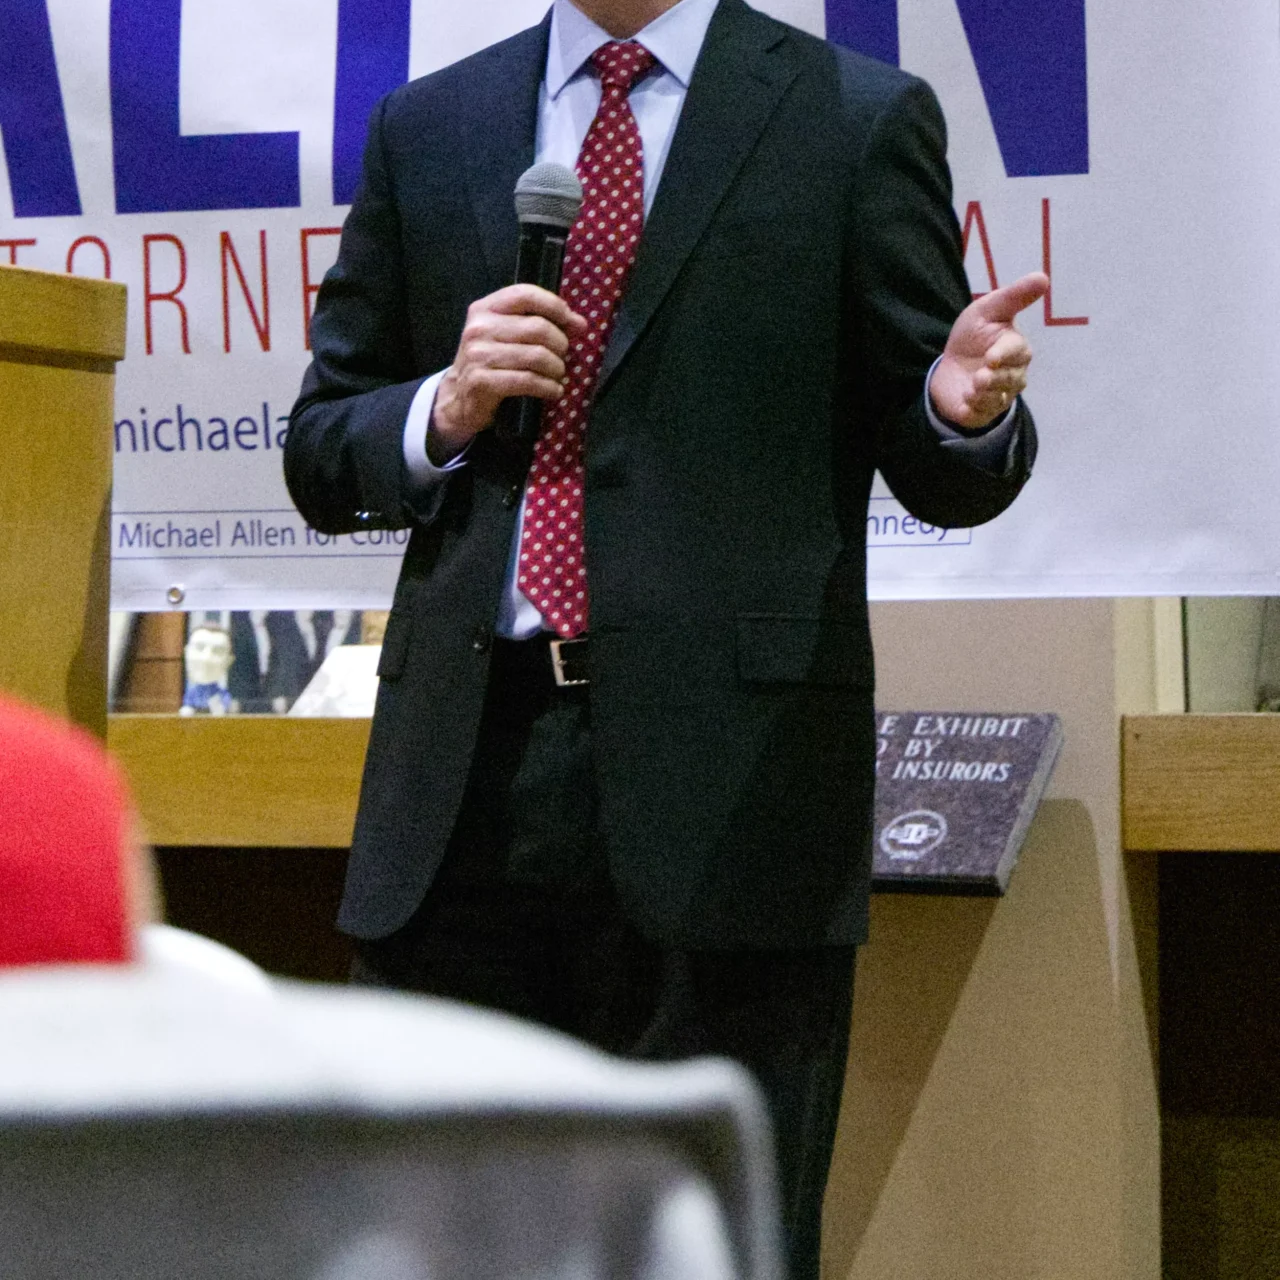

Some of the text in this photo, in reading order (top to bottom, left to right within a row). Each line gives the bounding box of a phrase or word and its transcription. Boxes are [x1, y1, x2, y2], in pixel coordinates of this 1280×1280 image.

[120, 519, 220, 548] Michael
[231, 519, 296, 548] Allen
[913, 716, 1029, 737] EXHIBIT
[904, 738, 943, 758] BY
[892, 760, 1012, 783] INSURORS
